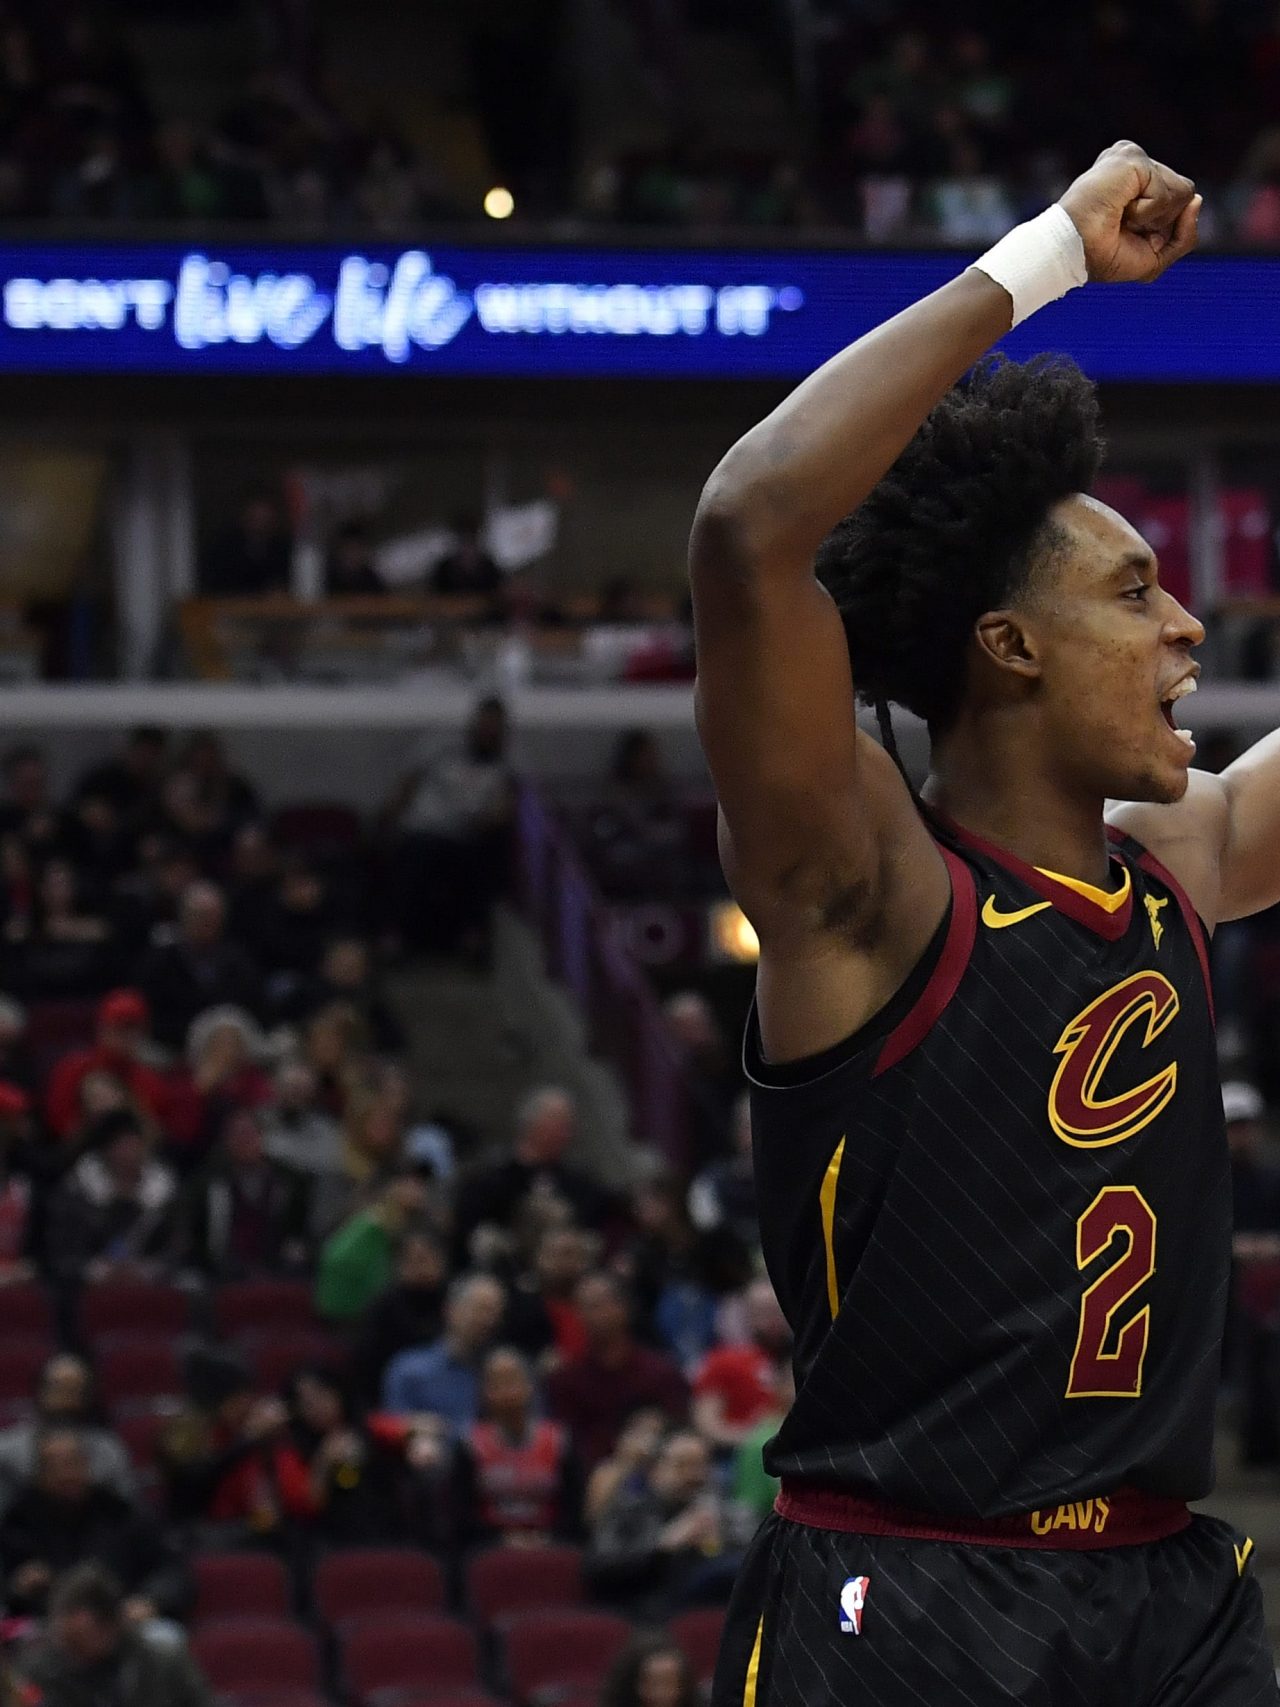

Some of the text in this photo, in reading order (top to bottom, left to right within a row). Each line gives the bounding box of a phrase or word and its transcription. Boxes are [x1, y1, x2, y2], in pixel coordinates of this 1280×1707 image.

[1048, 969, 1180, 1149] C
[1064, 1185, 1157, 1398] 2
[1030, 1496, 1110, 1535] CAVS
